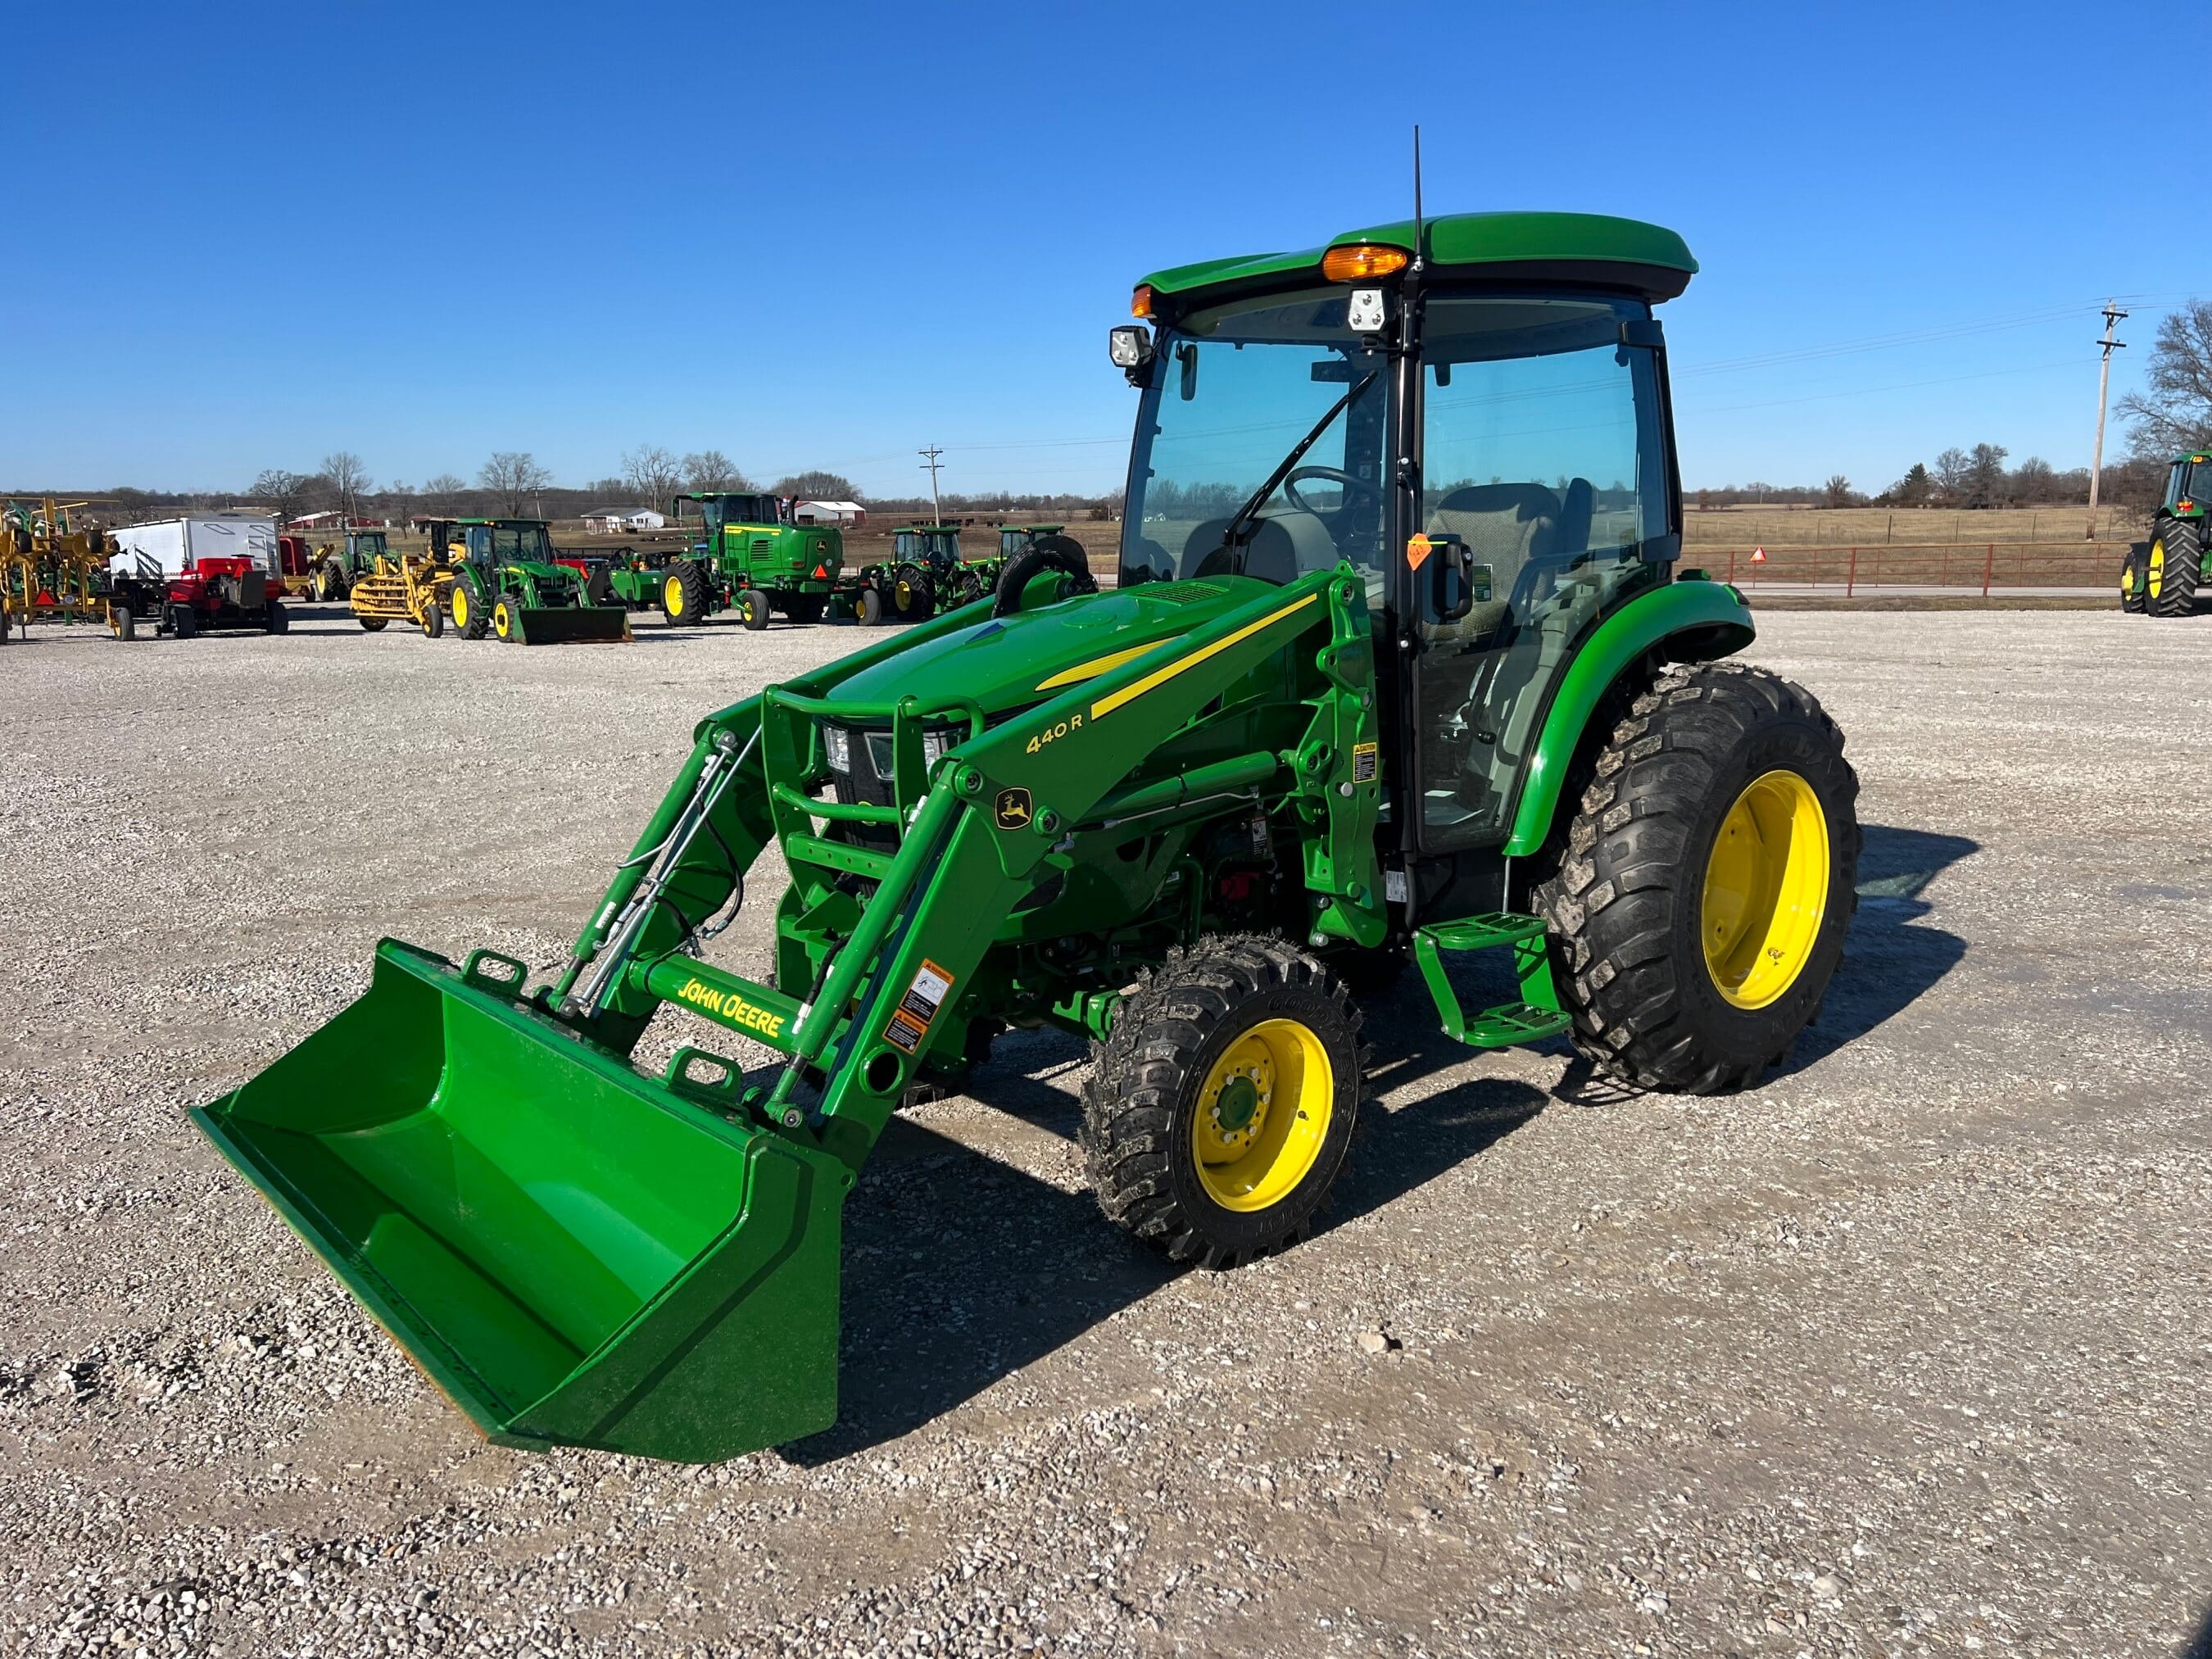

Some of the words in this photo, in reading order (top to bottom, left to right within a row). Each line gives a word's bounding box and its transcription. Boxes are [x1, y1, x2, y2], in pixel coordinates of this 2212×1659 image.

[1026, 722, 1067, 754] 440
[678, 977, 726, 1013] JOHN
[722, 994, 785, 1038] DEERE
